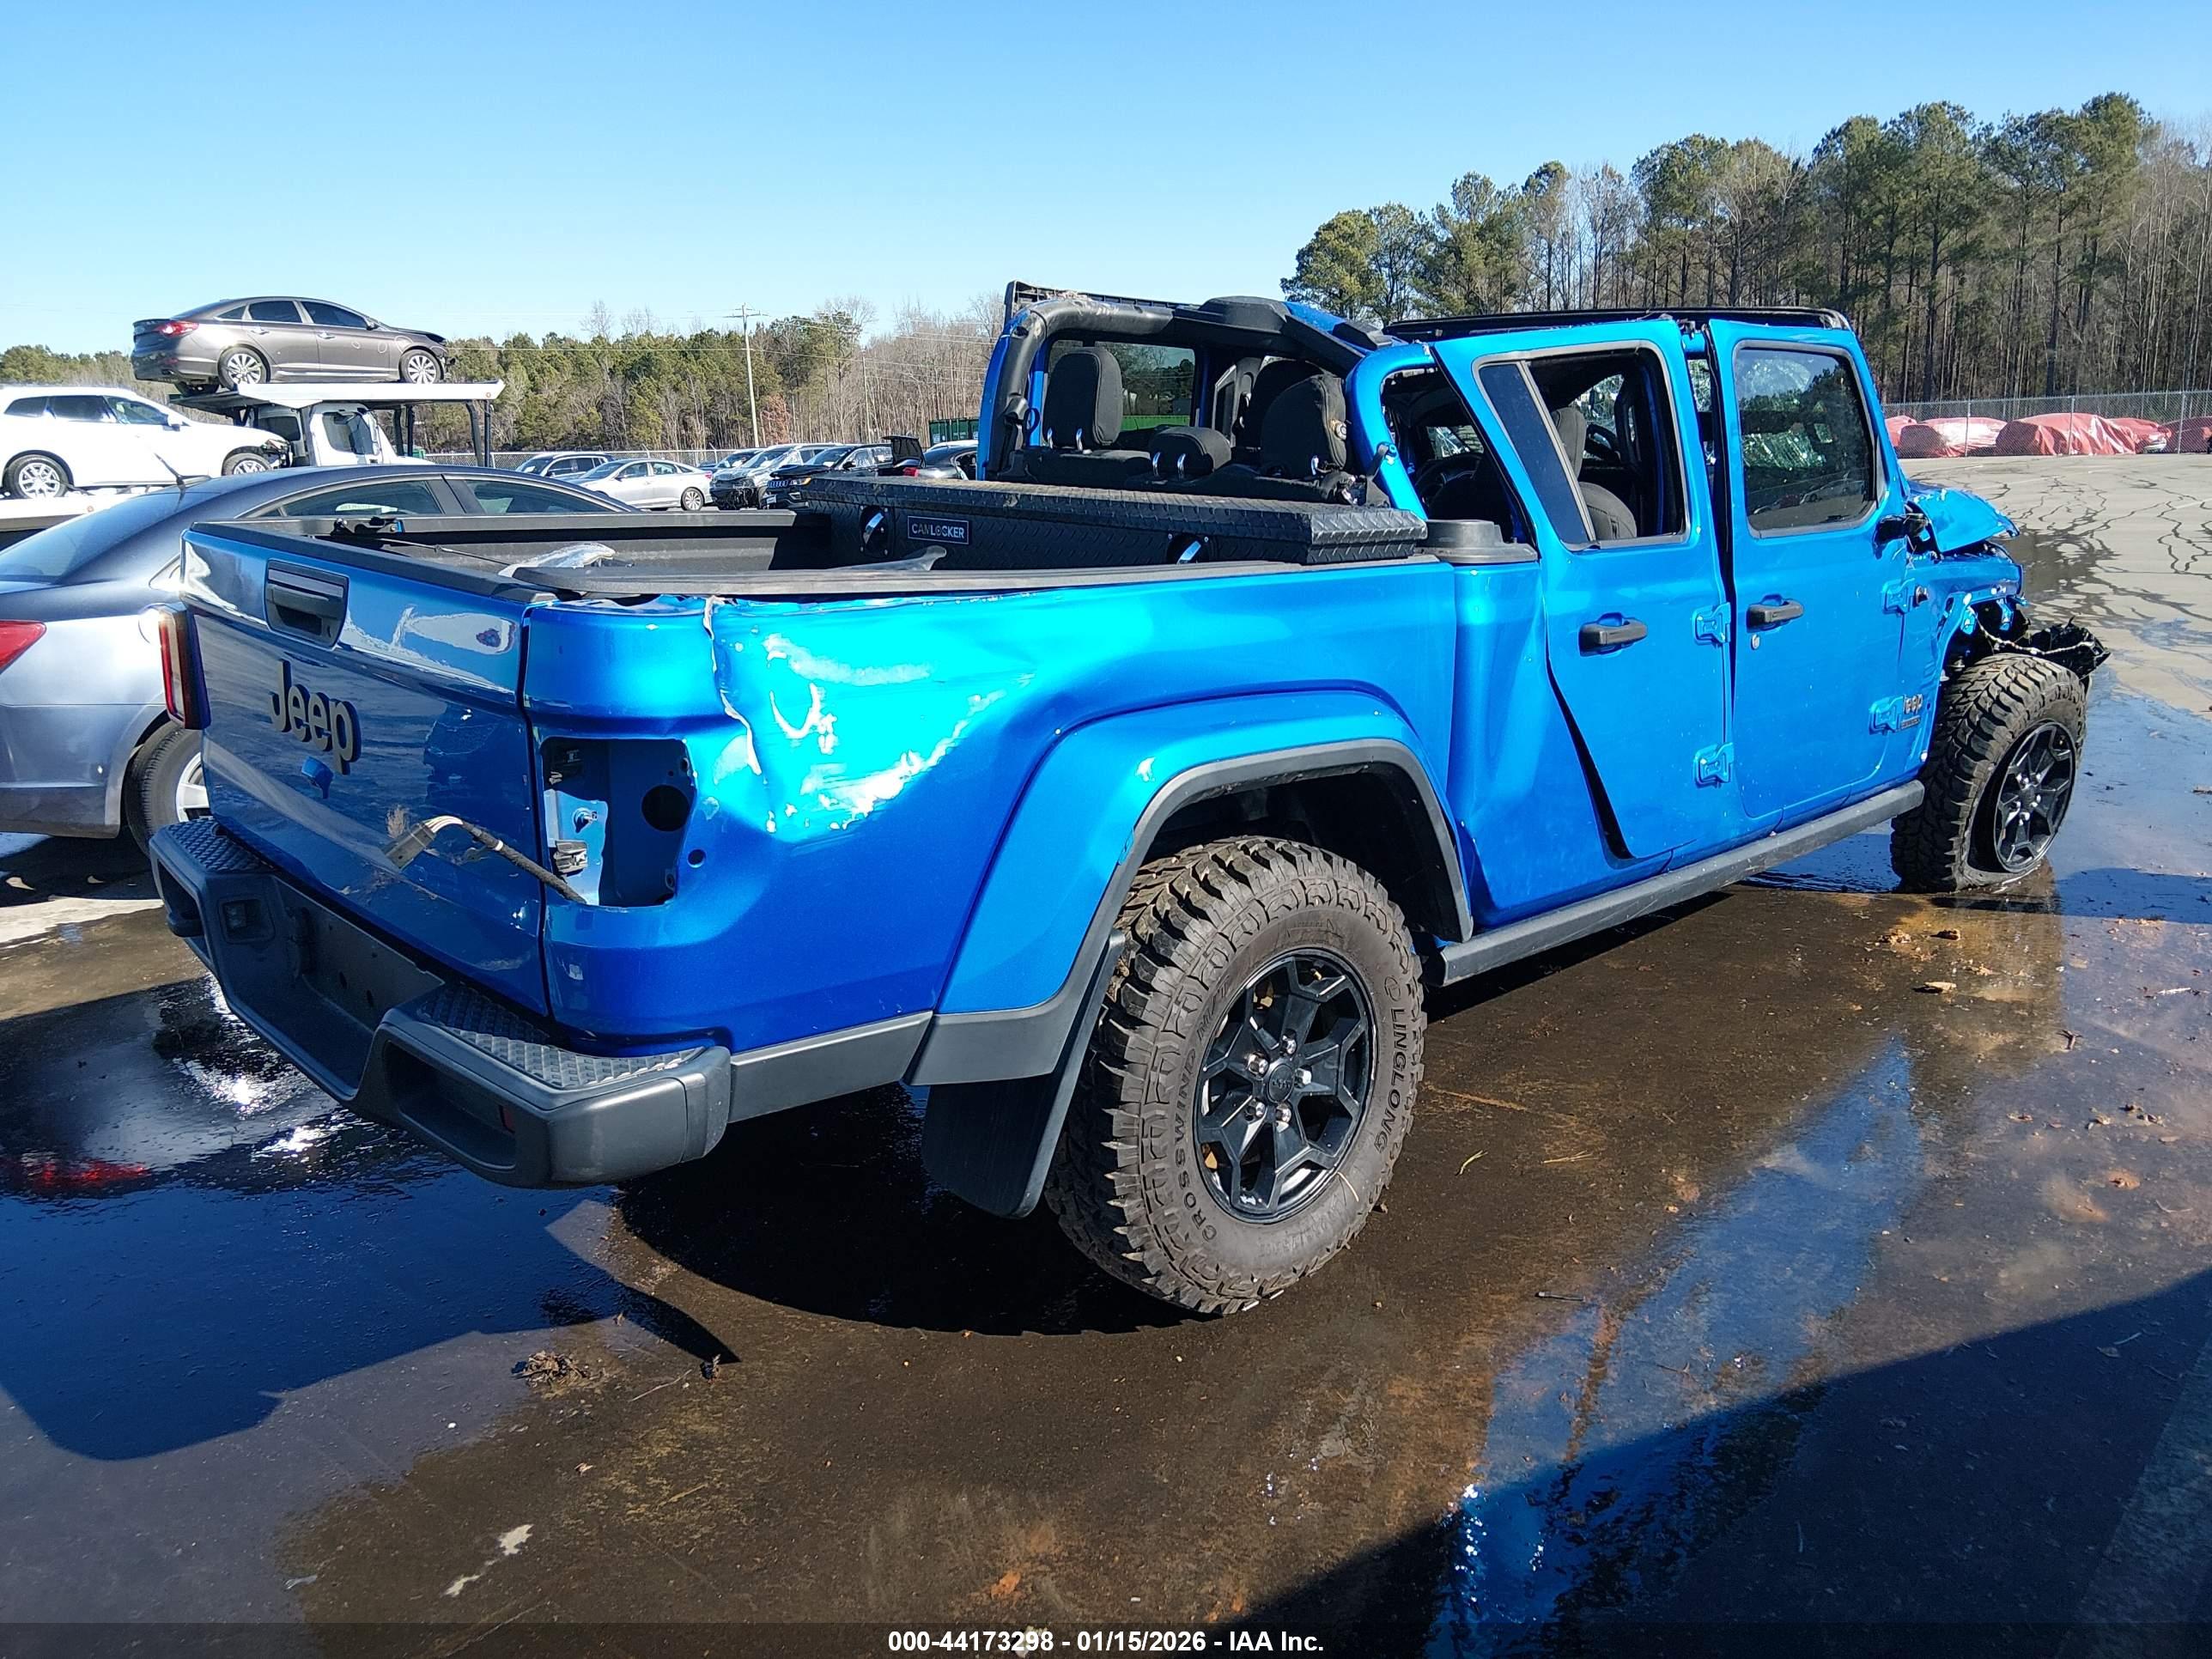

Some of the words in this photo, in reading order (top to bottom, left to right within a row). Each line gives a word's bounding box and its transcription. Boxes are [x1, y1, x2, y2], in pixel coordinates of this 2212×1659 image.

[268, 658, 362, 776] Jeep
[1175, 1048, 1217, 1242] CROSSWIND
[1374, 1008, 1407, 1154] LINGLONG
